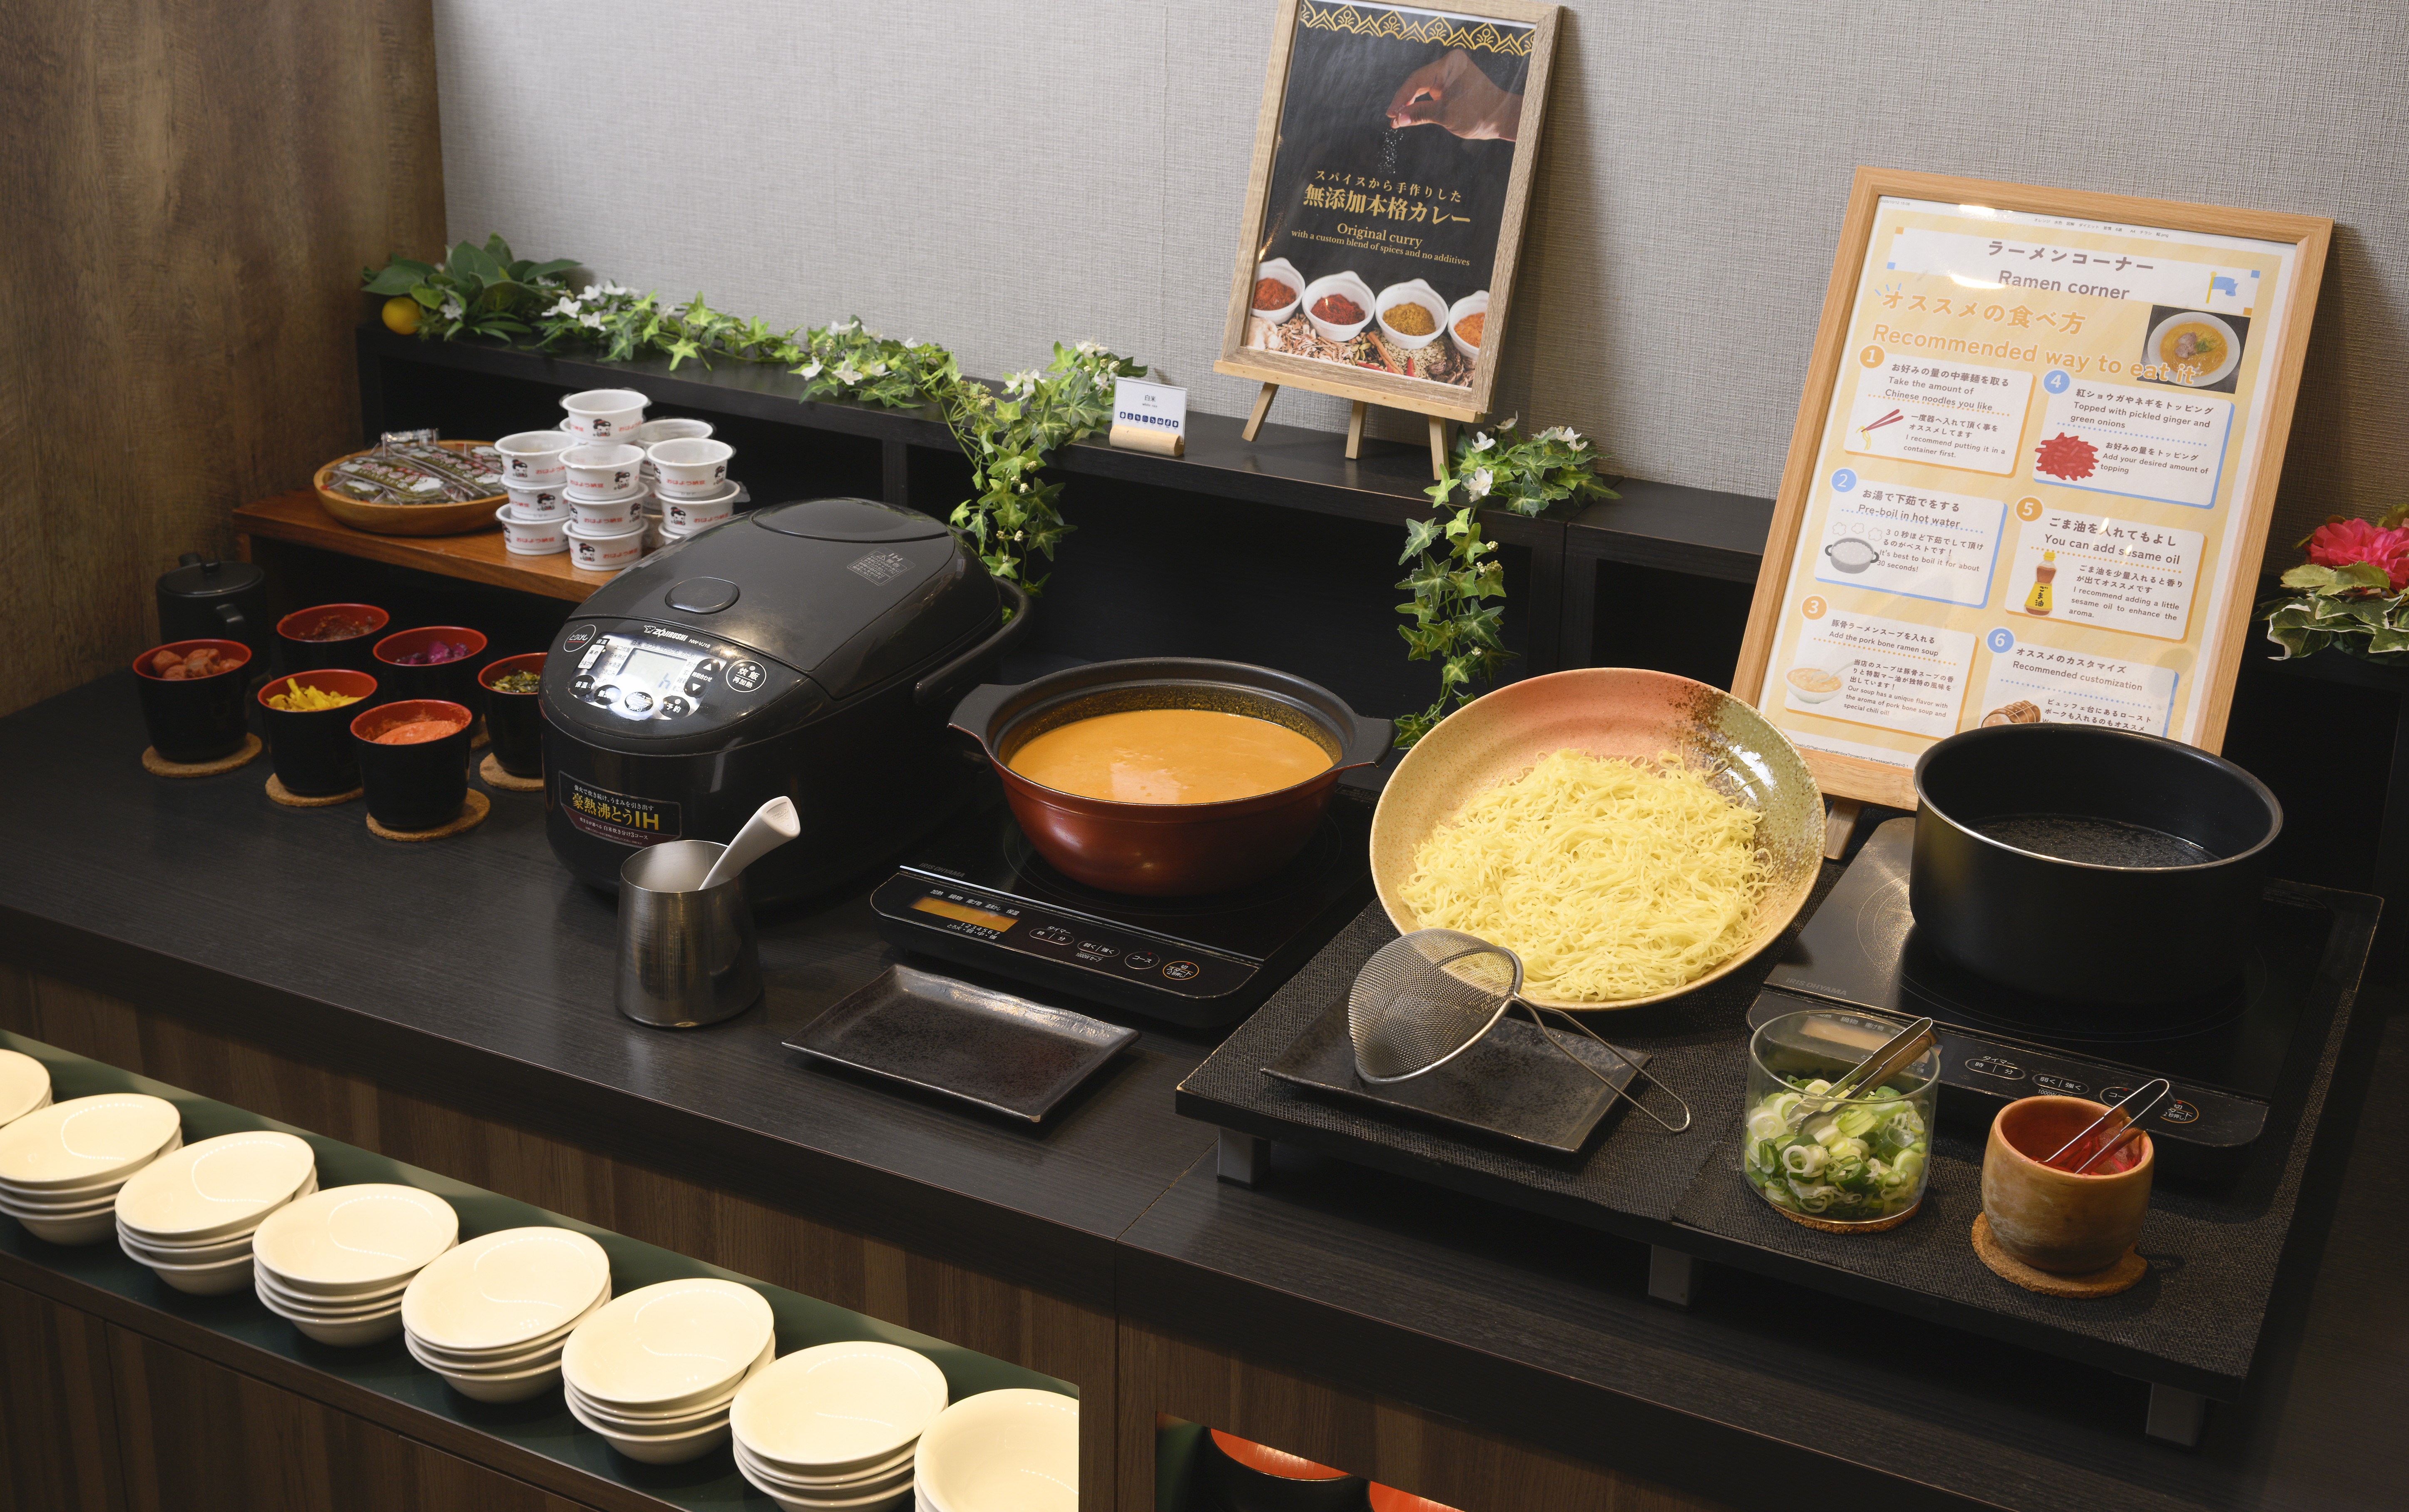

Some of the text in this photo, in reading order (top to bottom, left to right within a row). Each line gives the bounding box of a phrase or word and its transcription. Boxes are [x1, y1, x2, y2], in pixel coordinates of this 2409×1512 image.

[1315, 170, 1461, 202] スパイスから手作りした
[1303, 184, 1470, 224] 無添加本格カレー
[1338, 223, 1423, 249] Original curry
[1291, 230, 1308, 239] with
[1316, 235, 1344, 244] custom
[1346, 239, 1368, 249] blend
[1380, 246, 1403, 254] spices
[1405, 249, 1420, 257] and
[1434, 254, 1470, 266] additives
[1988, 241, 2154, 272] ラーメンコーナー
[1998, 270, 2130, 300] Ramen corner
[1882, 291, 2087, 335] オススメの食べ方
[1867, 350, 1875, 363] 1
[1872, 324, 2195, 385] Recommended way to eat it
[1889, 376, 1909, 386] Take
[1929, 383, 1961, 393] amount
[1892, 364, 2009, 387] お好みの量の中華麺を取る
[2051, 375, 2061, 388] 4
[1885, 389, 1993, 410] Chinese noodles you like
[2076, 388, 2213, 415] 紅ショウガやネギをトッピング
[1911, 414, 1998, 432] 一度器へ入れて頂く事を
[2070, 415, 2125, 428] green onions
[2073, 402, 2210, 428] Topped with pickled ginger and
[1909, 423, 1972, 438] オススメしてます
[1911, 435, 1952, 446] recommend
[1954, 442, 1980, 452] putting
[2106, 442, 2199, 461] お好みの量をトッピング
[2101, 464, 2129, 474] topping
[2103, 453, 2118, 461] Add
[2120, 456, 2137, 465] your
[2139, 458, 2167, 468] desired
[2170, 463, 2198, 472] amount
[1837, 474, 1847, 487] 2
[1862, 490, 1960, 512] お湯で下茹でをする
[2022, 502, 2034, 516] 5
[1858, 504, 1960, 528] Pre-boil in hot water
[1893, 551, 1909, 560] best
[2045, 534, 2180, 565] You can add sesame oil
[1887, 561, 1919, 572] seconds!
[2080, 565, 2183, 588] ごま油を少量入れると香り
[2076, 576, 2153, 594] が出てオススメです
[2035, 587, 2049, 607] ごま油
[1808, 601, 1819, 614] 3
[2069, 609, 2095, 618] aroma.
[2071, 598, 2099, 607] sesame
[2103, 602, 2113, 610] oil
[2129, 607, 2160, 618] enhance
[2165, 612, 2177, 621] the
[652, 628, 711, 648] ZOJIRUSHI NW-VJ18
[1831, 619, 1935, 644] 豚骨ラーメンスープを入れる
[1995, 633, 2006, 647] 6
[1846, 633, 1857, 642] the
[1859, 637, 1875, 646] pork
[1877, 640, 1895, 649] bone
[1897, 644, 1919, 653] ramen
[1922, 648, 1939, 657] soup
[1854, 659, 1954, 683] 当店のスープは豚骨スープの香
[2016, 648, 2127, 674] オススメのカスタマイズ
[733, 676, 753, 688] 再加熱
[738, 667, 760, 680] 炊飯
[2013, 661, 2143, 691] Recommended customization
[666, 704, 681, 713] 予約
[2048, 699, 2151, 723] ビュッフェ台にあるロースト
[934, 867, 965, 878] OHYAMA
[1806, 982, 1847, 995] OHYAMA
[1983, 1055, 2015, 1066] タイマー
